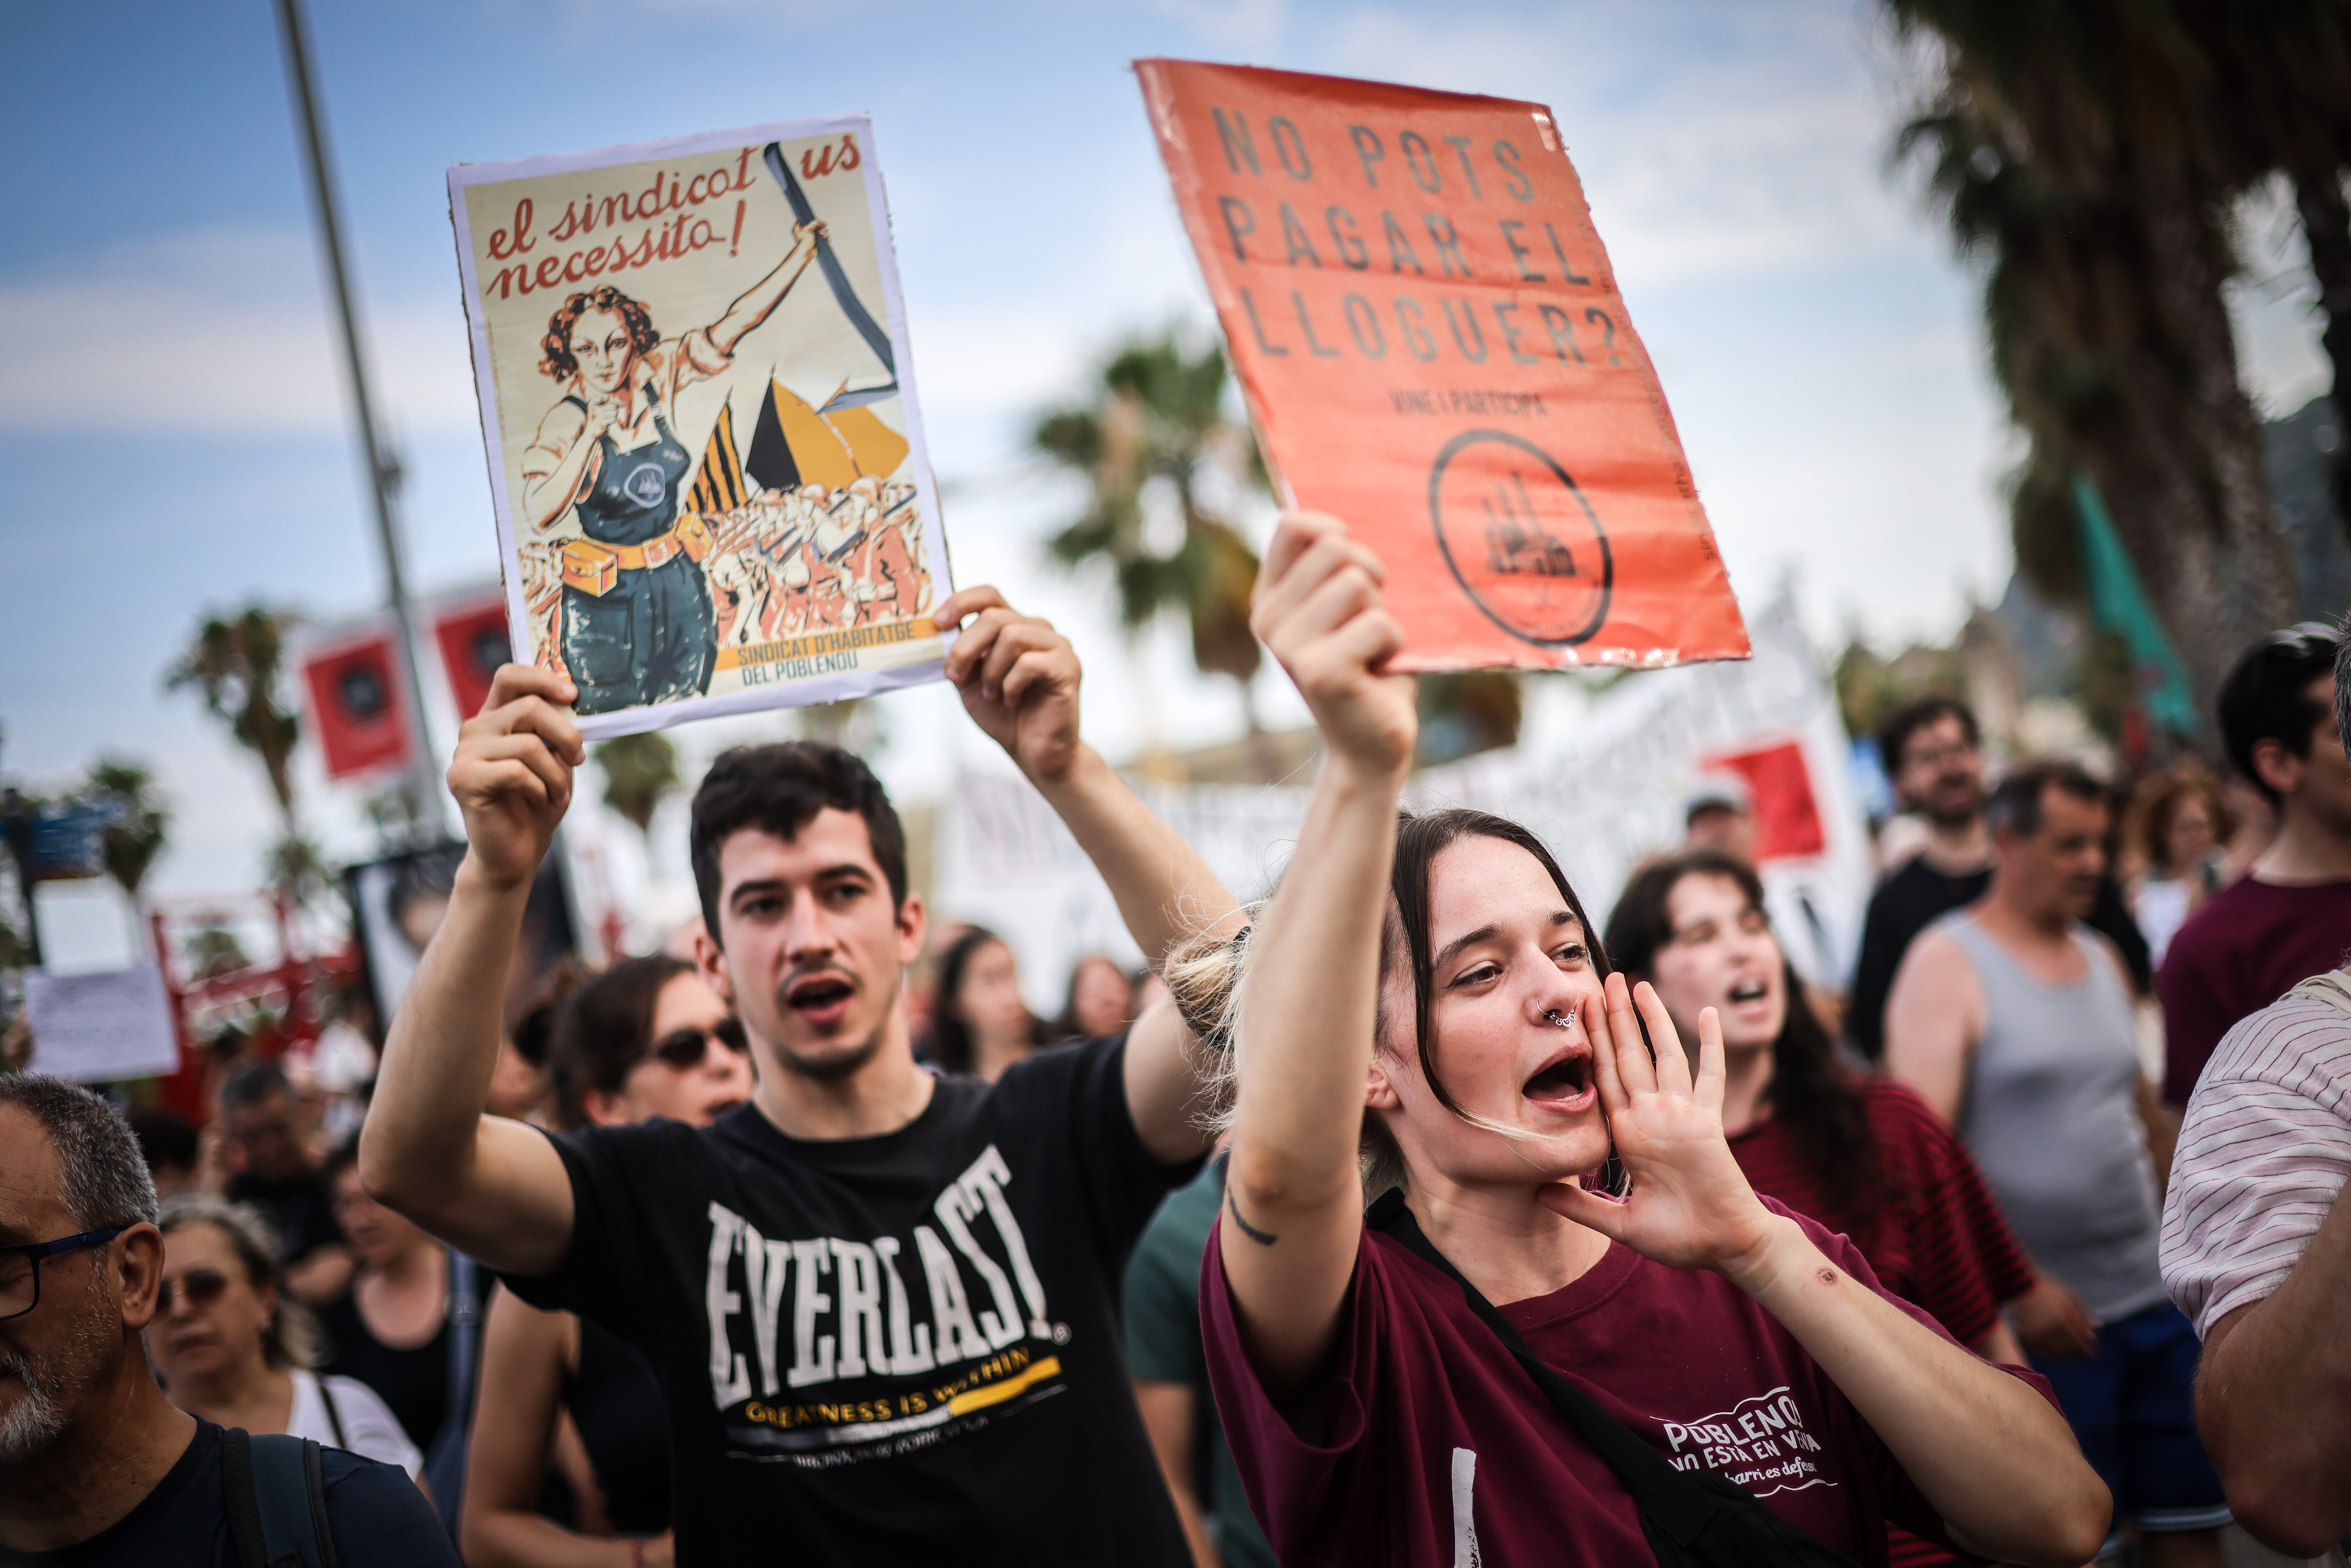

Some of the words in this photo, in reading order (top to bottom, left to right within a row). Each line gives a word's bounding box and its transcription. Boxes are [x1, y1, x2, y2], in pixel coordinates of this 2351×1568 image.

[1213, 107, 1313, 182] NO
[1348, 125, 1535, 203] POTS
[486, 198, 536, 260] el
[549, 146, 759, 242] sindicat
[800, 134, 861, 180] us
[486, 200, 746, 300] necessita!
[1218, 196, 1473, 280] PAGAR
[1500, 221, 1591, 287] EL
[1239, 287, 1622, 369] LLOGUER?
[737, 638, 810, 666] SINDICAT
[814, 621, 916, 653] D'HABITATGE
[742, 663, 772, 686] DEL
[776, 651, 859, 681] POBLENOU
[706, 1144, 1052, 1413] EVERLAST
[746, 1400, 892, 1428] GREATNESS
[900, 1392, 927, 1414] IS
[1703, 1445, 1753, 1468] ESTÀ
[1752, 1440, 1781, 1459] EN
[1765, 1465, 1781, 1479] es
